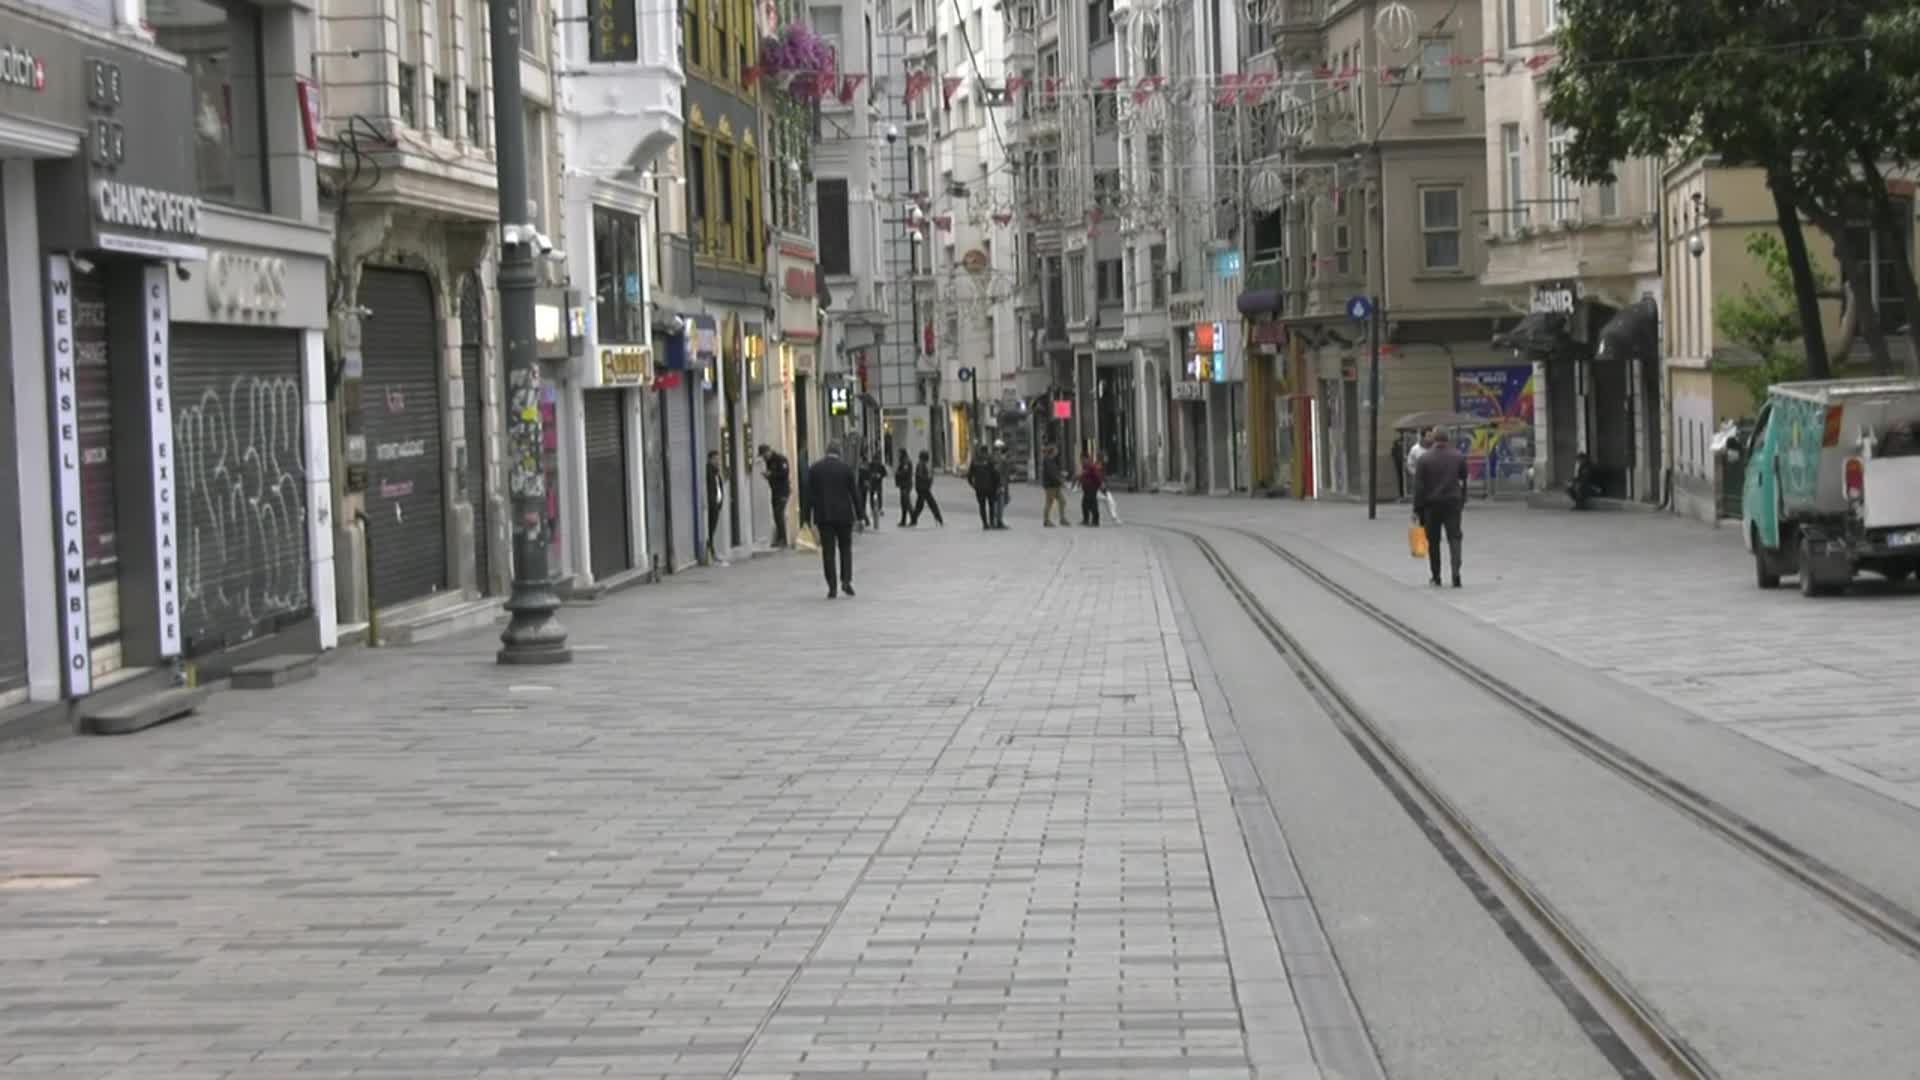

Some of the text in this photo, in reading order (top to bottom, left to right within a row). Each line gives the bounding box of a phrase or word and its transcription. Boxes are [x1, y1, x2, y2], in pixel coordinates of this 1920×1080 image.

[100, 180, 158, 229] CHANGE
[151, 283, 164, 414] CHANGE
[52, 279, 86, 670] WECHSEL CAMBIO
